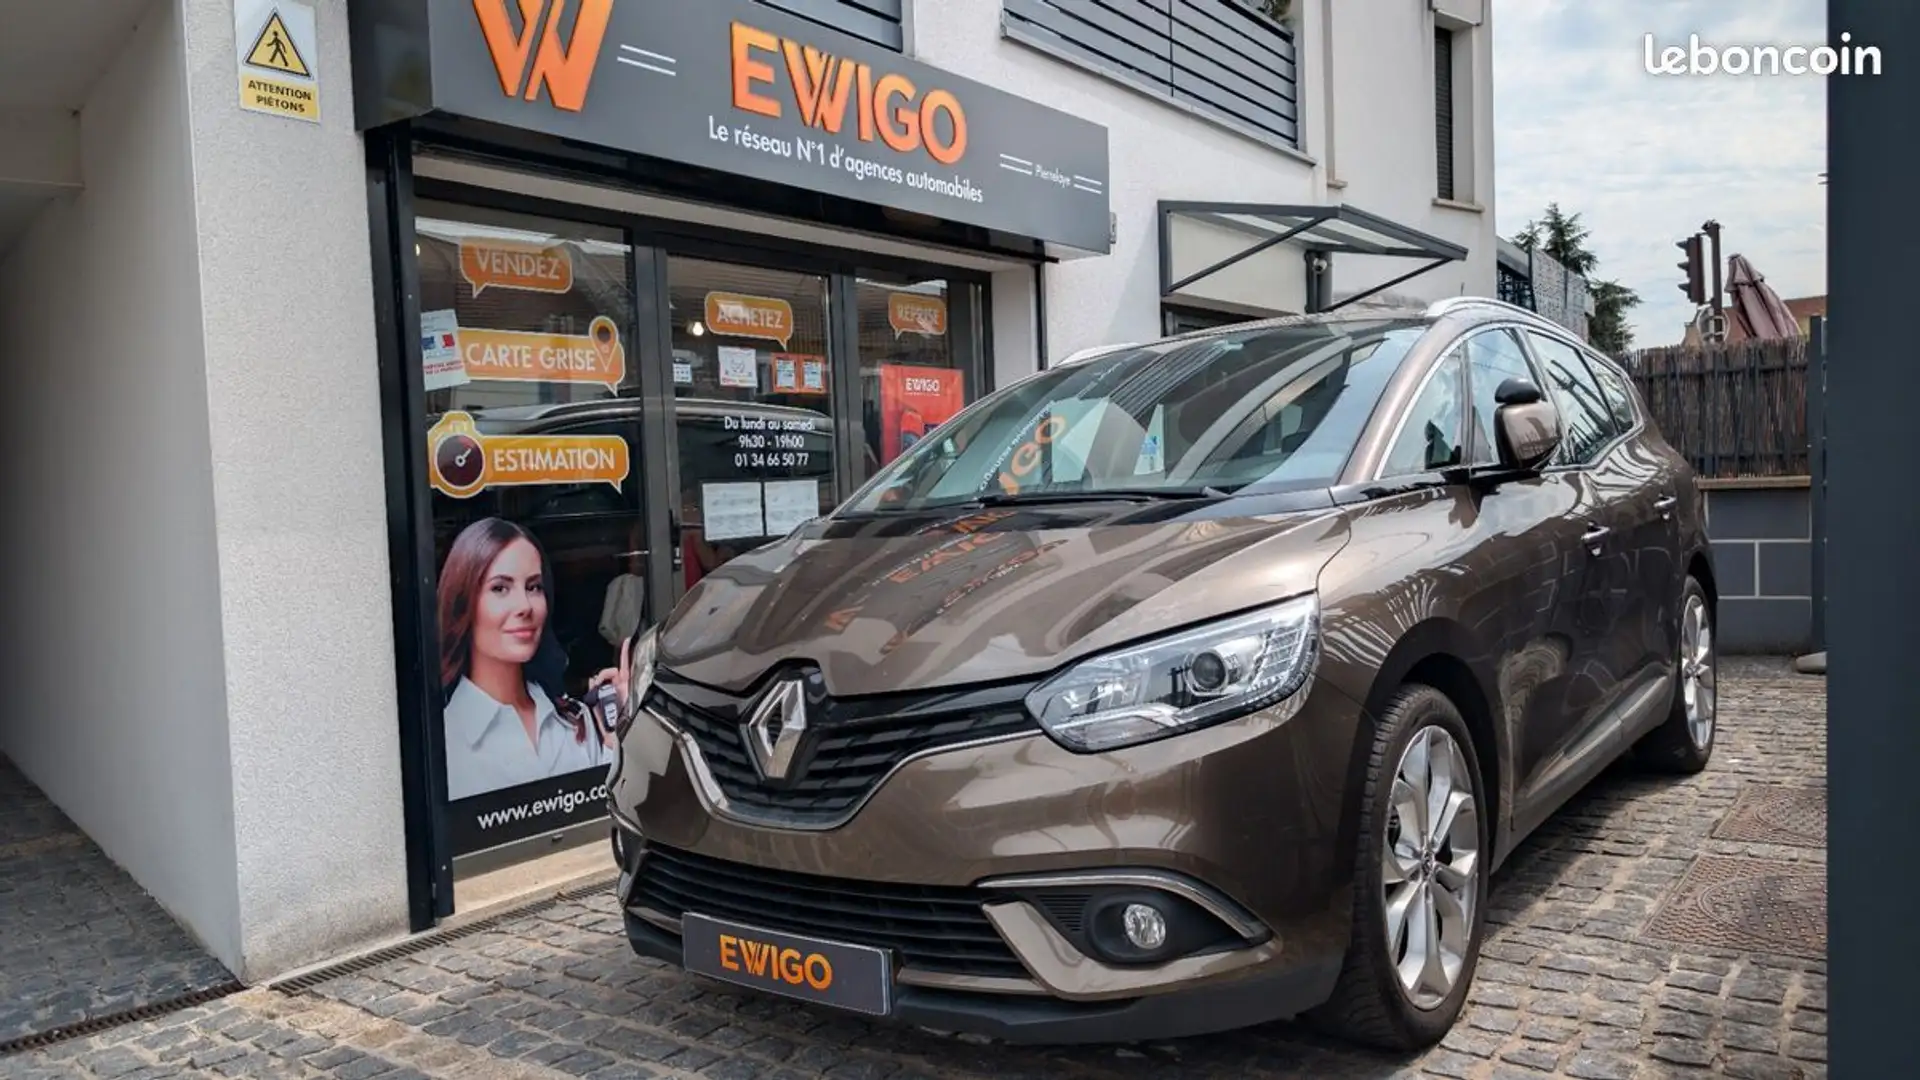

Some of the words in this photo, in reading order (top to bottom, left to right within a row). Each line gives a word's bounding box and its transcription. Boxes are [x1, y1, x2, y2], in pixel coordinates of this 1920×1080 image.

[247, 79, 312, 101] ATTENTION
[730, 20, 967, 165] EWIGO
[255, 94, 306, 113] PIÉTONS
[708, 115, 729, 142] Le
[734, 125, 792, 158] réseau
[796, 136, 826, 166] N°1
[829, 144, 903, 182] d'agences
[906, 170, 984, 203] automobiles
[475, 247, 562, 280] VENDEZ
[716, 303, 784, 329] ACHETEZ
[465, 342, 532, 369] CARTE
[538, 346, 597, 371] GRISE
[904, 377, 940, 393] EWIGO
[724, 415, 740, 430] Du
[741, 414, 766, 431] lundi
[768, 417, 780, 430] au
[782, 416, 817, 431] samedi
[738, 434, 765, 448] 9h30
[775, 434, 804, 449] 19h00
[493, 447, 615, 472] ESTIMATION
[734, 453, 748, 467] 01
[751, 453, 765, 467] 34
[766, 453, 780, 467] 66
[782, 453, 795, 467] 50
[796, 453, 810, 467] 77
[477, 784, 607, 830] www.ewigo.co
[719, 933, 834, 991] EWIGO
